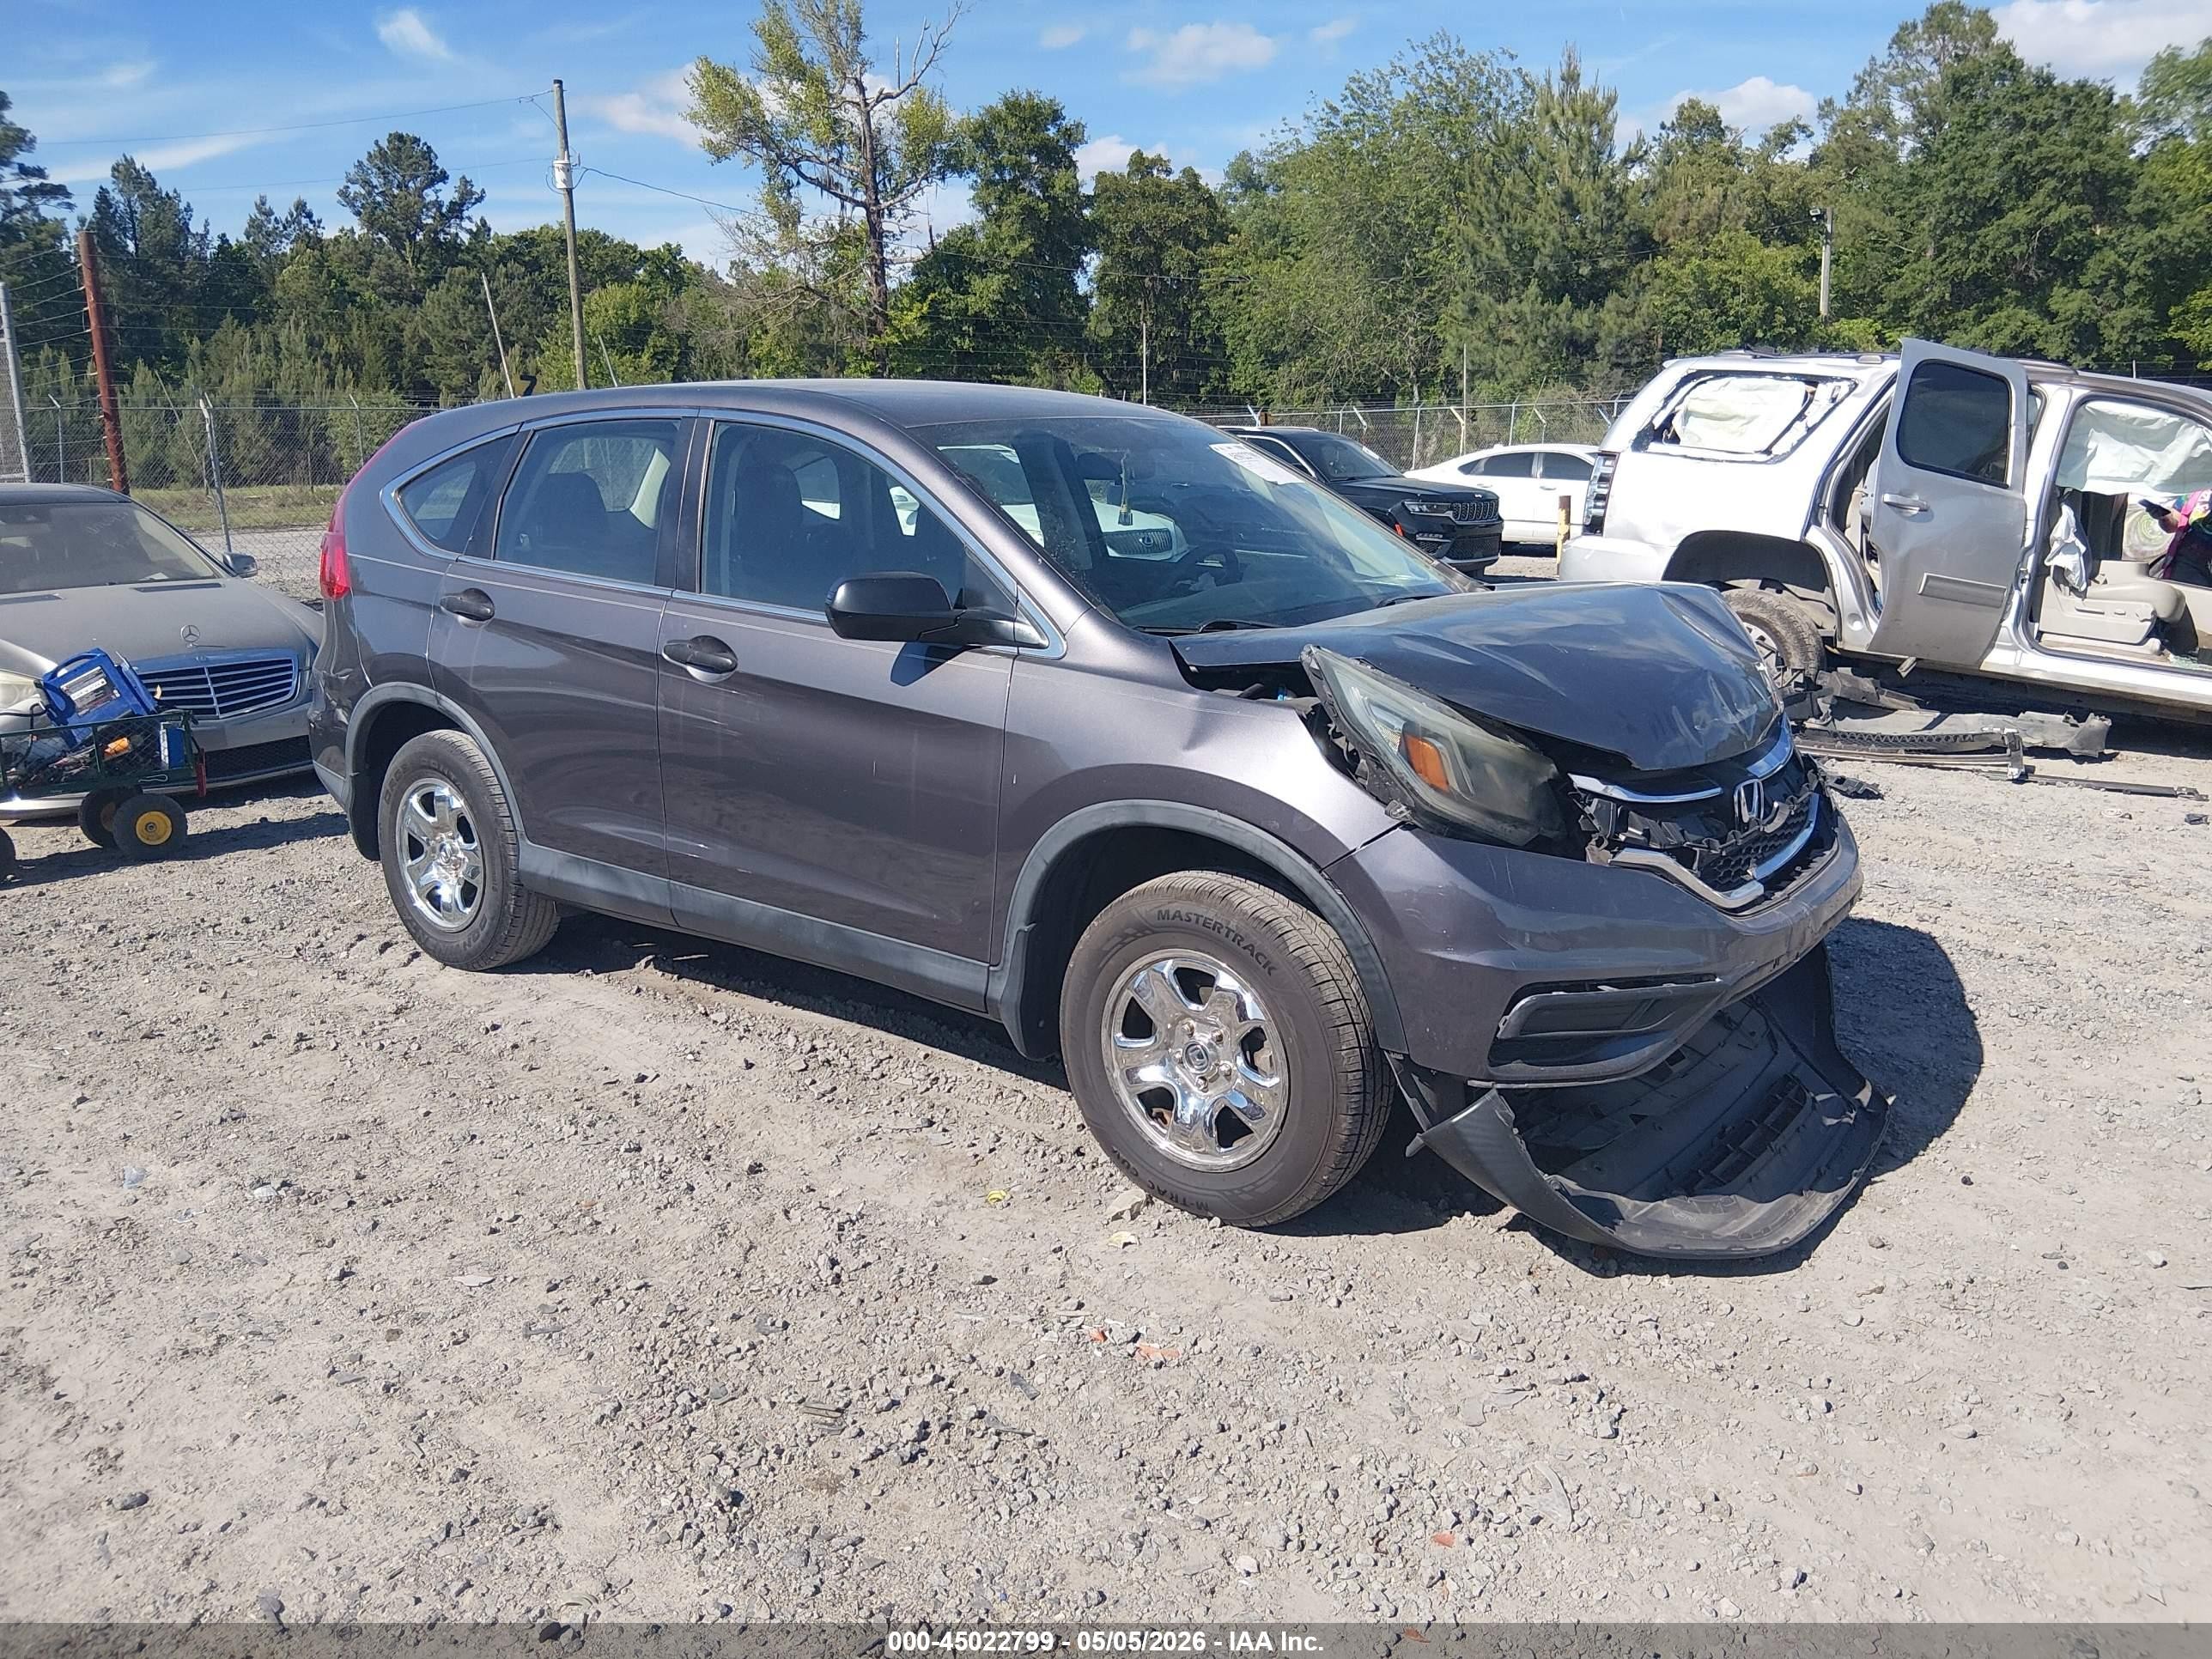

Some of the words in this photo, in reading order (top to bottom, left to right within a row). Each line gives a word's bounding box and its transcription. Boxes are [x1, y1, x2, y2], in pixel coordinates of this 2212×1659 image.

[1469, 410, 1478, 422] 2
[1157, 908, 1278, 976] MASTERTRACK
[1146, 1180, 1210, 1212] M-TRAC
